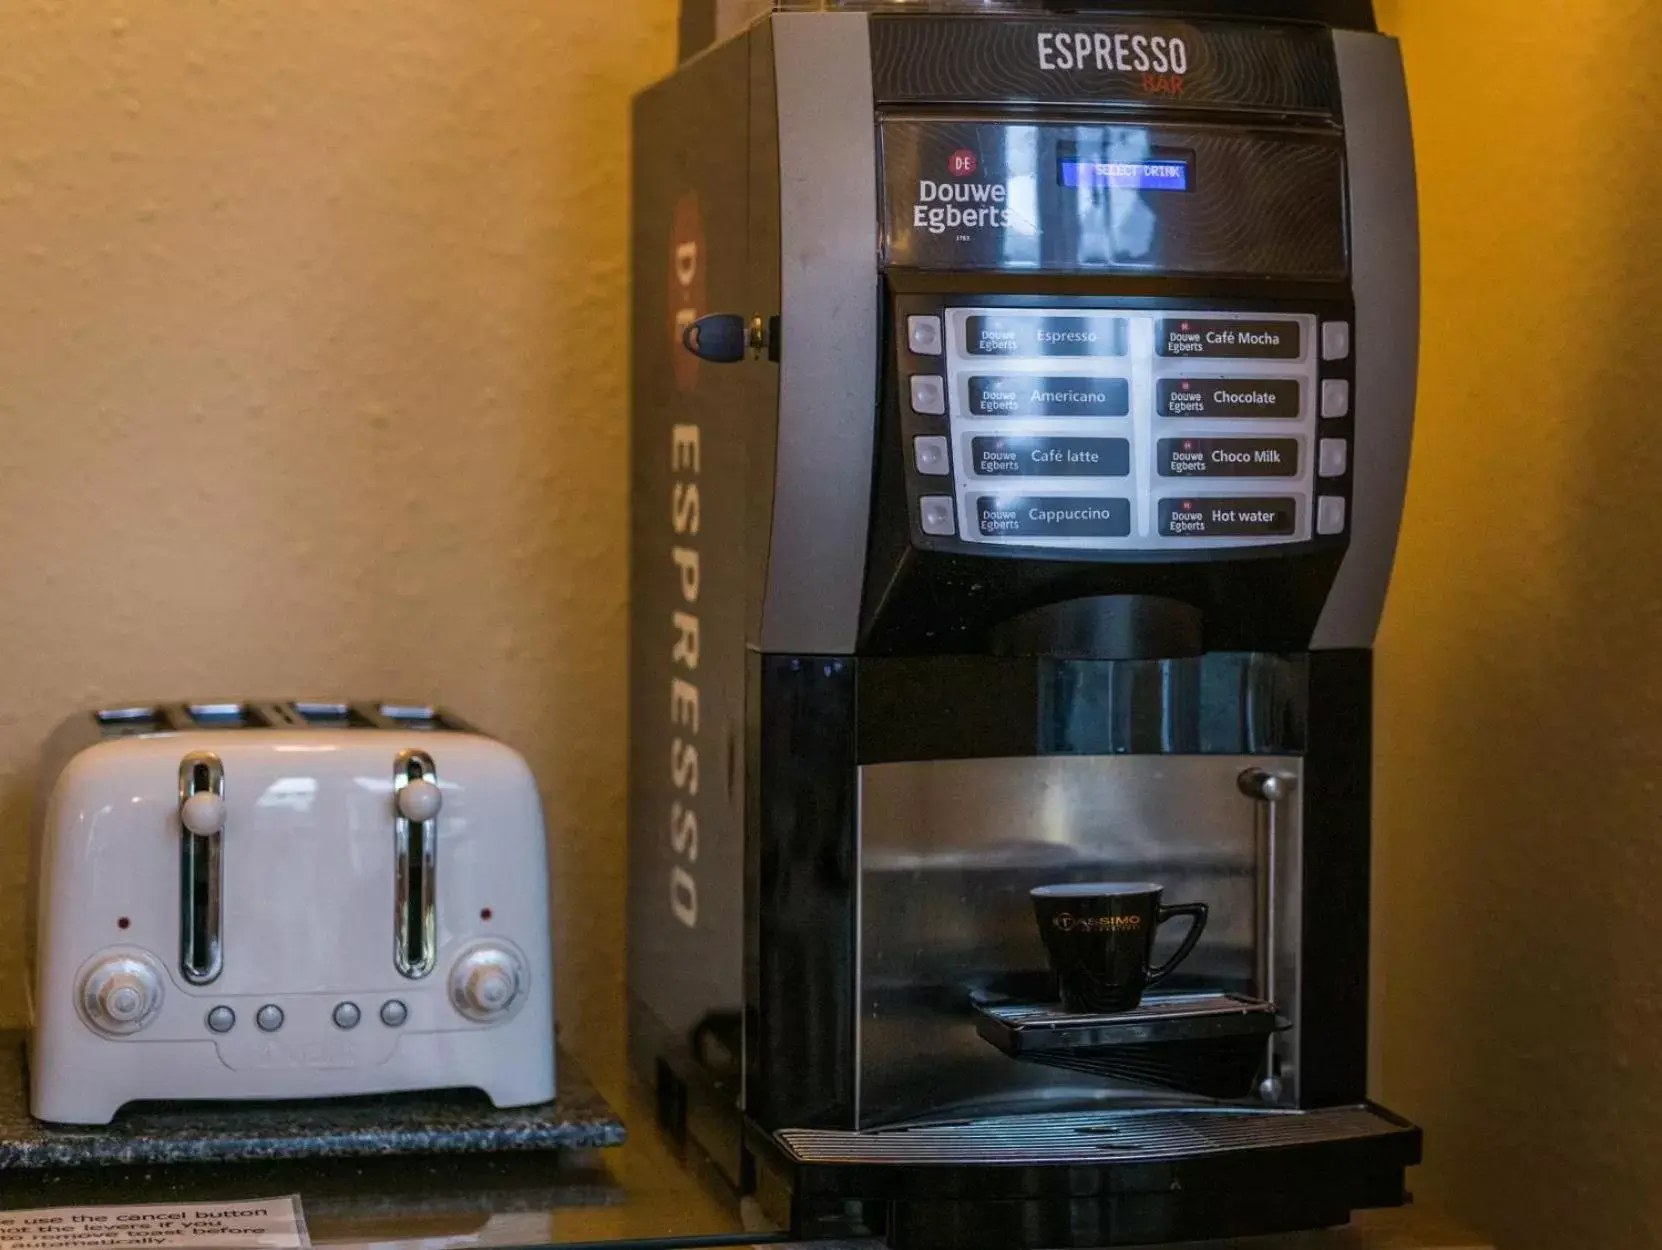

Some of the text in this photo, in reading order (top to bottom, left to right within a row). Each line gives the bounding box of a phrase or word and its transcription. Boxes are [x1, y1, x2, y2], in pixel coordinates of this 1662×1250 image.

[1037, 33, 1188, 74] ESPRESSO
[1140, 73, 1184, 95] BAR
[1095, 164, 1181, 177] SELECT DRINK
[919, 180, 1008, 202] Douwe
[913, 204, 1013, 234] Egberts
[1037, 330, 1097, 344] Espresso
[1169, 332, 1201, 342] Douwe
[1205, 331, 1281, 345] Café Mocha
[1168, 342, 1204, 354] Egberts
[1030, 390, 1106, 402] Americano
[1171, 392, 1202, 401] Douwe
[1213, 391, 1277, 404] Chocolate
[1169, 402, 1204, 413] Egberts
[983, 451, 1017, 461] Douwe
[1031, 449, 1099, 463] Café latte
[1172, 452, 1204, 461] Douwe
[1211, 450, 1281, 463] Choco Milk
[981, 461, 1019, 472] Egberts
[1171, 461, 1206, 473] Egberts
[983, 511, 1017, 520] Douwe
[1028, 507, 1110, 523] Cappuccino
[1171, 512, 1203, 521] Douwe
[1212, 509, 1275, 522] Hot water
[981, 520, 1019, 532] Egberts
[1170, 521, 1205, 533] Egberts
[672, 423, 700, 931] ESPRESSO
[24, 1216, 63, 1224] use
[71, 1214, 108, 1222] the
[116, 1211, 187, 1222] cancel
[195, 1208, 268, 1219] button
[39, 1225, 76, 1233] the
[84, 1222, 151, 1231] levers
[181, 1219, 222, 1229] you
[32, 1231, 118, 1240] remove
[127, 1229, 186, 1237] toast
[192, 1226, 266, 1235] before
